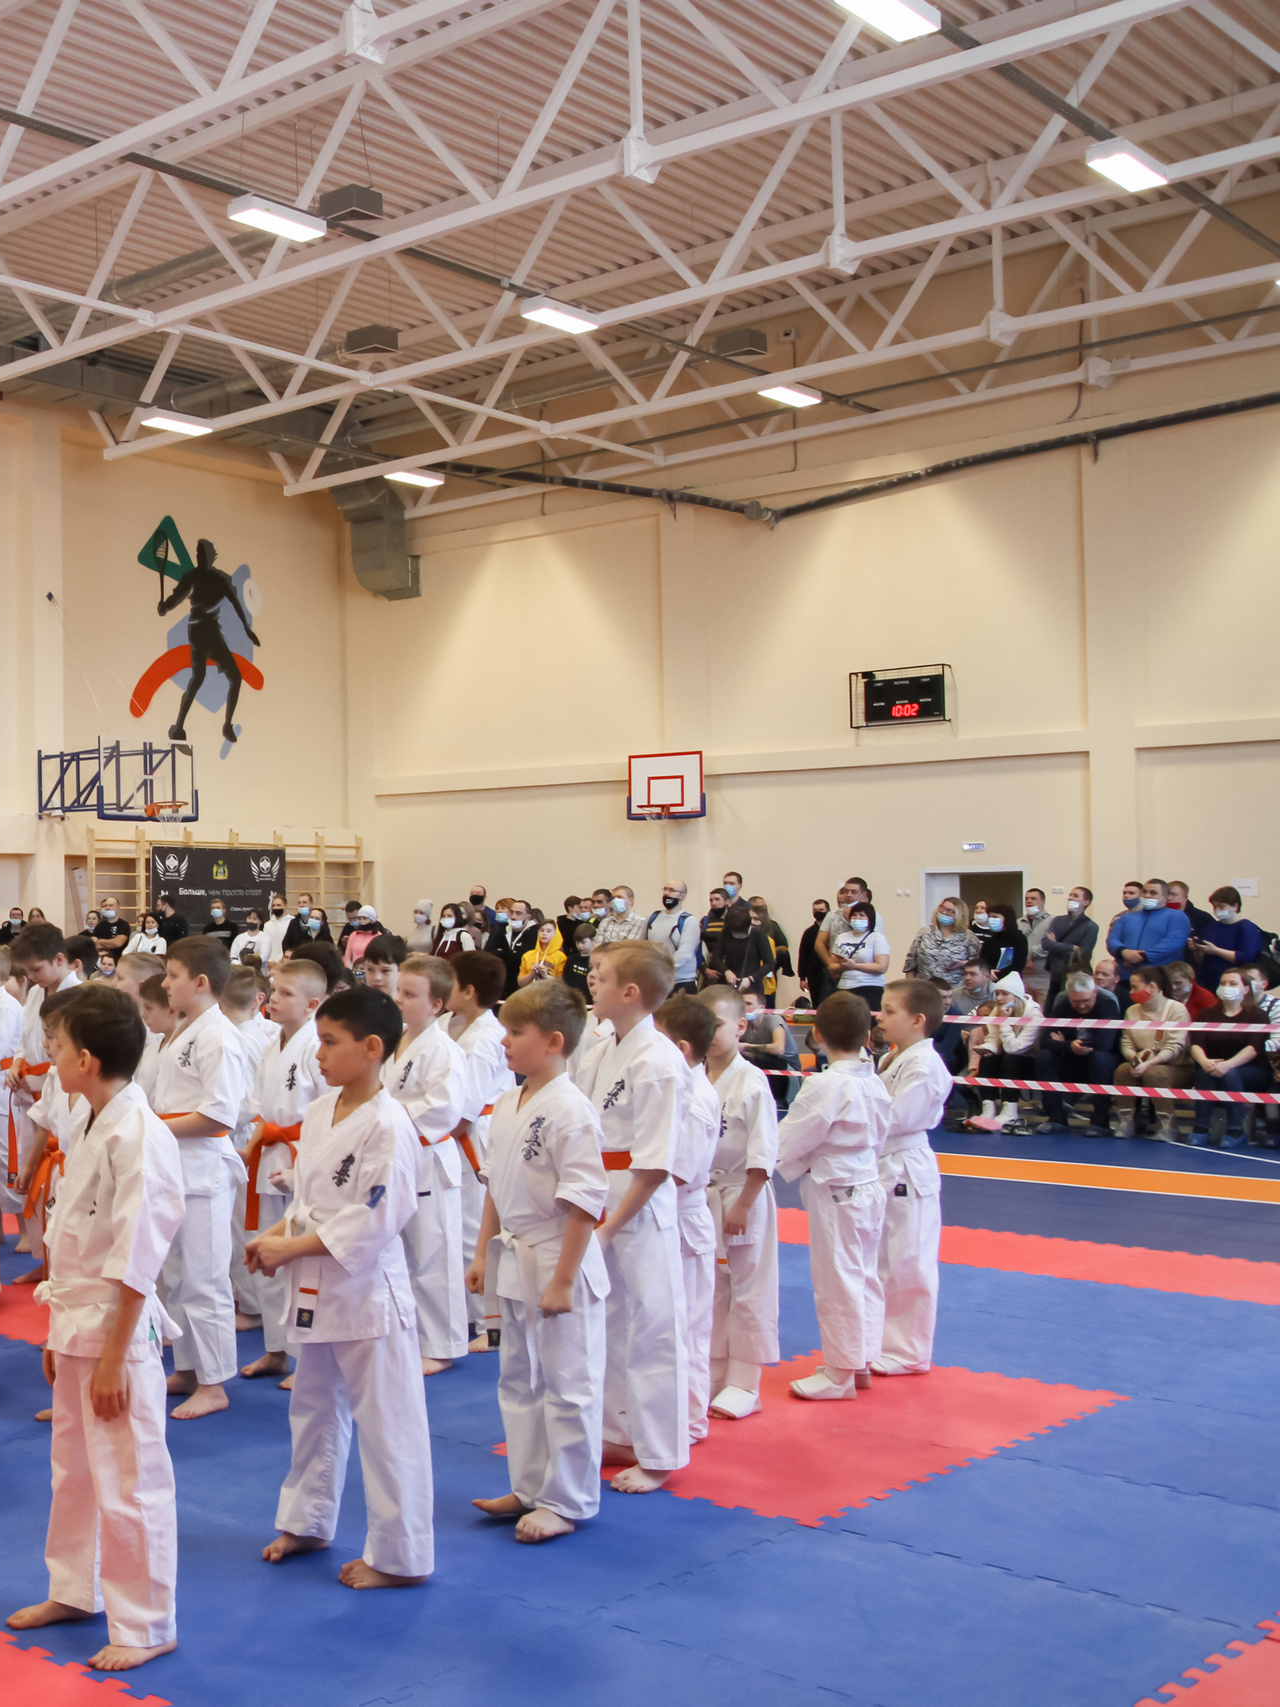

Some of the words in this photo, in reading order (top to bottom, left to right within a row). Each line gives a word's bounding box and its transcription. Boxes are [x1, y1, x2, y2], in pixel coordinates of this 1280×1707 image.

[178, 887, 207, 897] Больше,
[222, 889, 244, 897] просто
[245, 889, 262, 897] спорт
